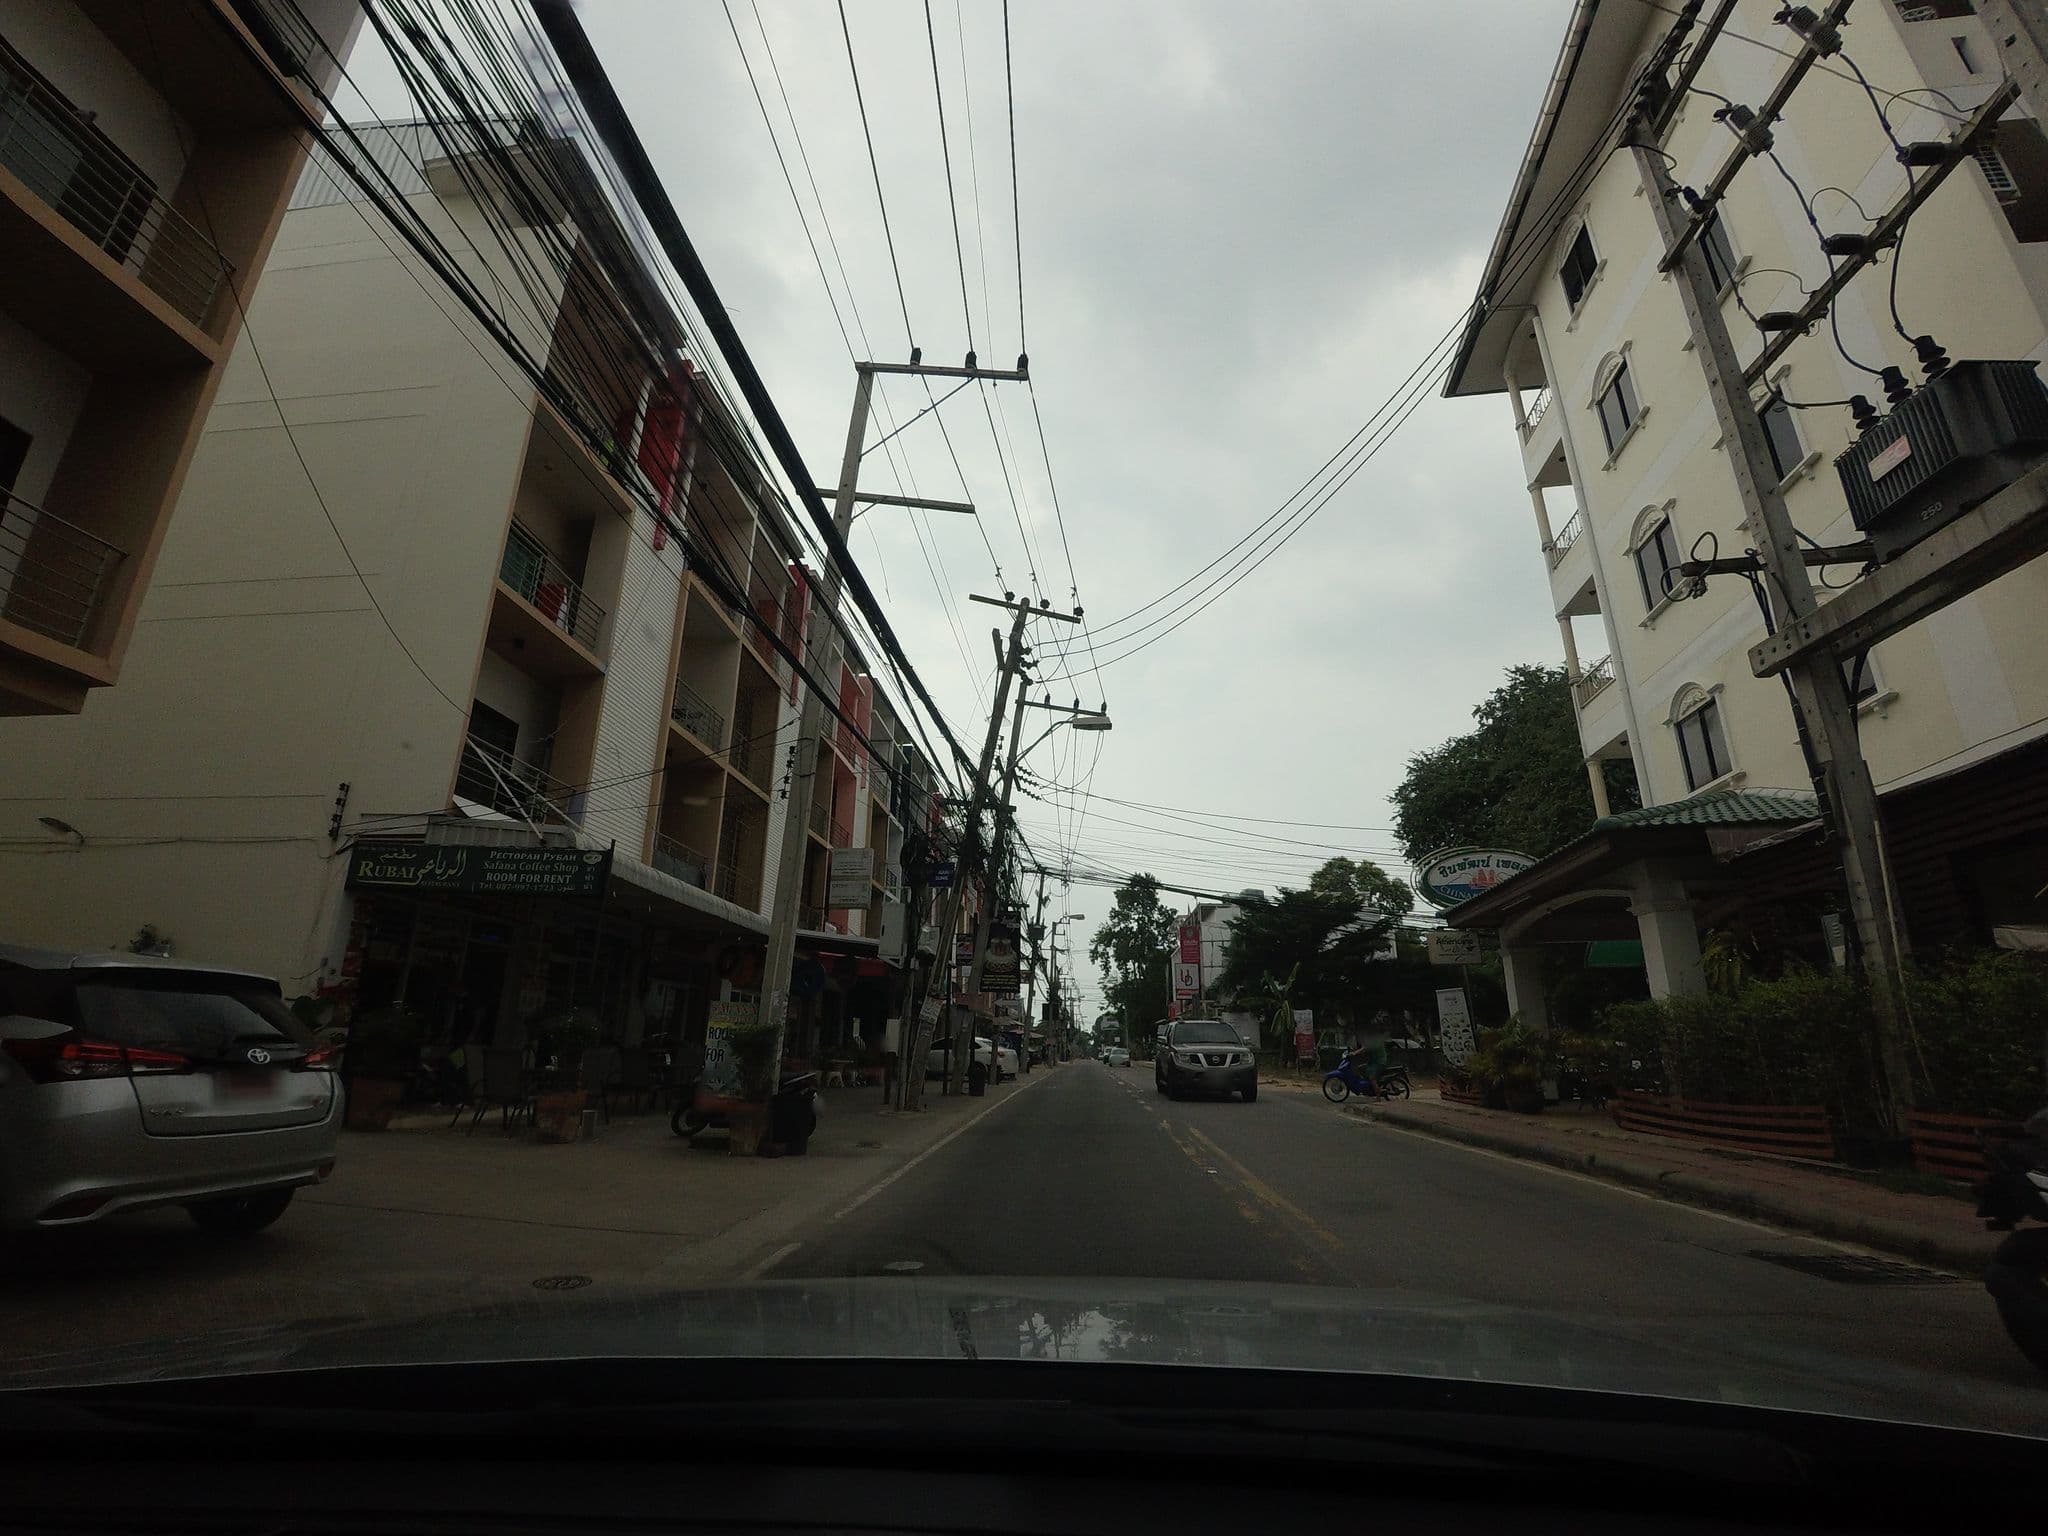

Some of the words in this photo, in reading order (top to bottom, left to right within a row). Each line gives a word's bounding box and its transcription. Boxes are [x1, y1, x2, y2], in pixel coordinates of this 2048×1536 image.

[1920, 501, 1943, 521] 250
[519, 862, 551, 872] Coffee
[553, 864, 579, 873] Shop
[487, 873, 517, 882] ROOM
[520, 874, 541, 883] FOR
[543, 875, 573, 884] RENT
[705, 1048, 725, 1062] FOR
